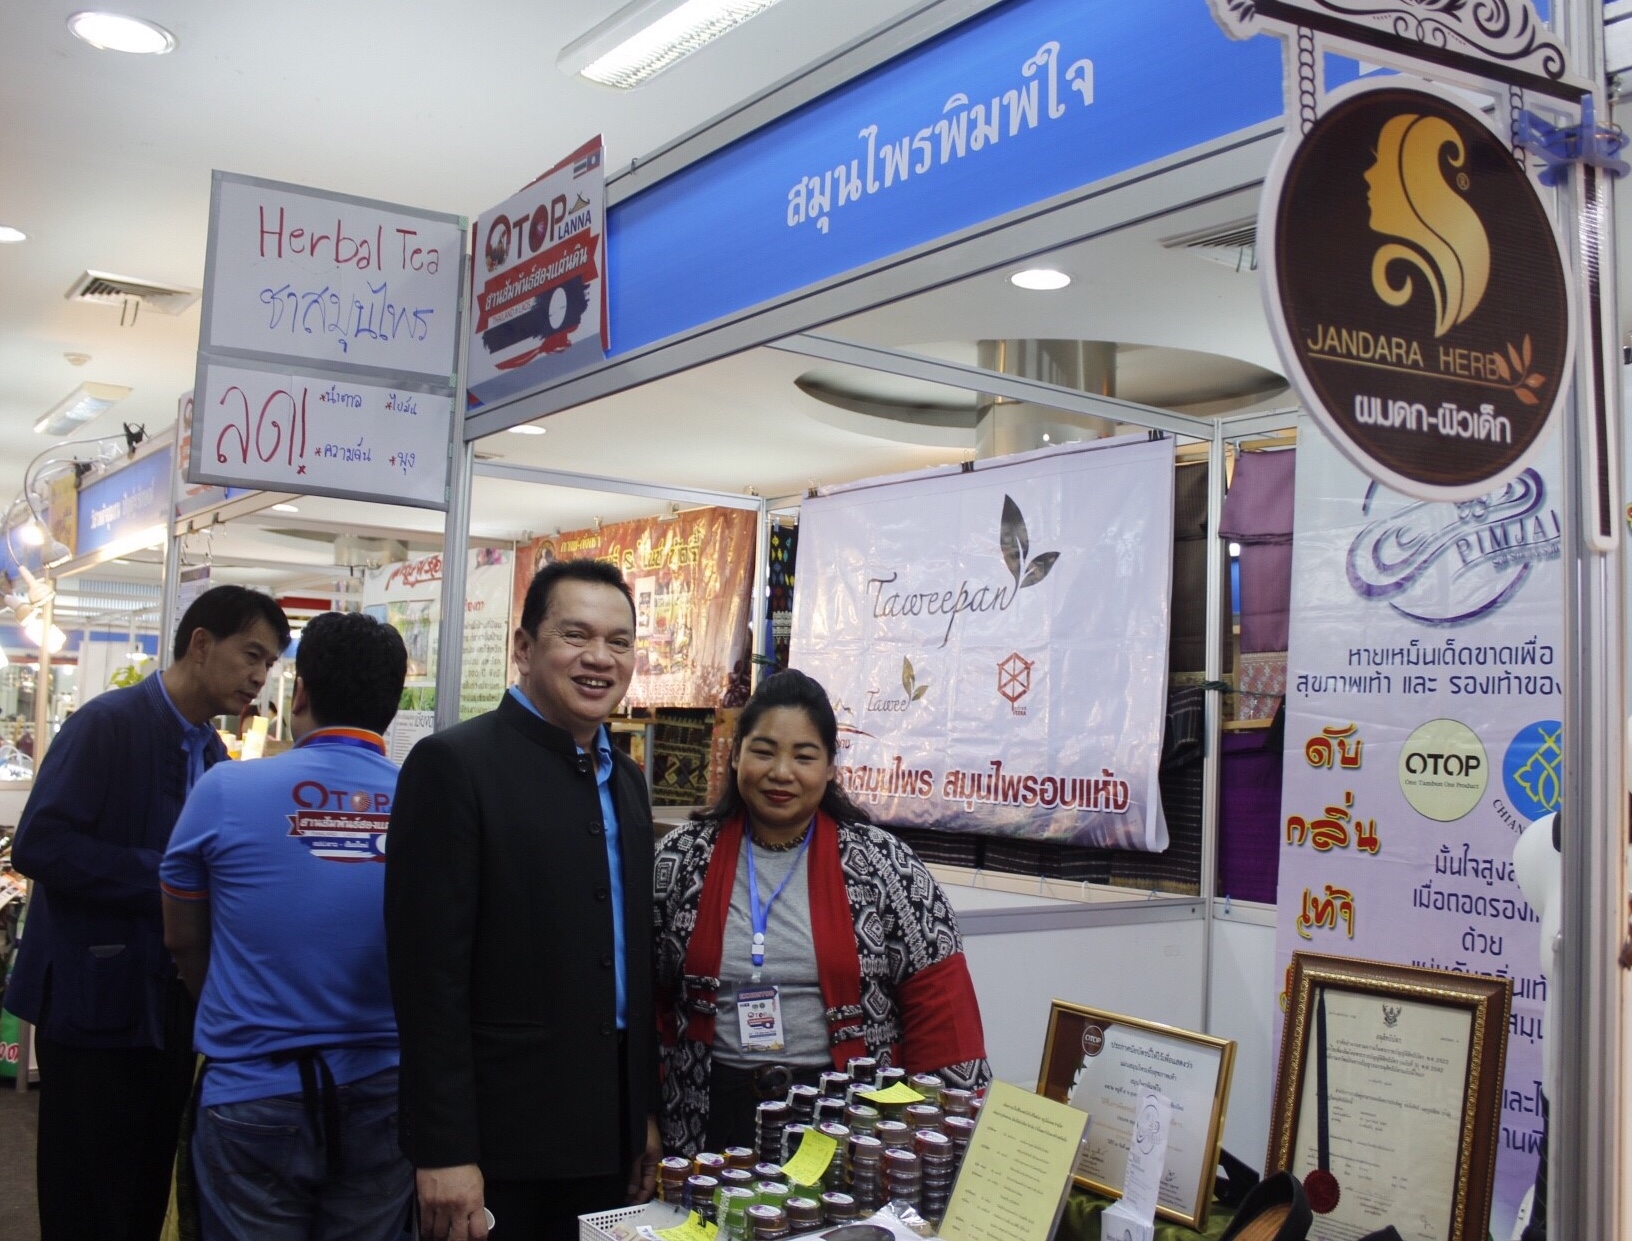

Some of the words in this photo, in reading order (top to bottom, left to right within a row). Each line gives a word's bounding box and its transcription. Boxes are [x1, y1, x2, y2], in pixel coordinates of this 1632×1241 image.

[787, 41, 1094, 234] สมุนไพรพิมพ์ใจ
[259, 205, 383, 270] Herbal
[396, 228, 439, 275] Tea
[485, 193, 567, 272] OTOP
[558, 210, 592, 241] LANNA
[485, 243, 588, 311] สานสัมพันธ์สองแผ่นดิน
[259, 281, 434, 354] ชาสมุนไพร
[1307, 324, 1424, 367] JANDARA
[1440, 346, 1500, 380] HERB
[216, 386, 308, 474] ลด!
[1355, 395, 1511, 444] ผมดก-ผิวเด็ก
[866, 571, 1012, 649] Taweepan
[1348, 635, 1554, 667] หายเหม็นเด็ดขาดเพื่อ
[866, 688, 909, 712] Tawee
[1296, 670, 1392, 697] สุขภาพเท้า
[1402, 675, 1437, 694] และ
[1305, 724, 1363, 768] ดับ
[1405, 752, 1481, 777] OTOP
[292, 780, 390, 813] OTOP
[942, 760, 1129, 812] สมุนไพรอบแห้ง
[1287, 792, 1380, 852] กลิ่น
[1462, 926, 1502, 956] ด้วย
